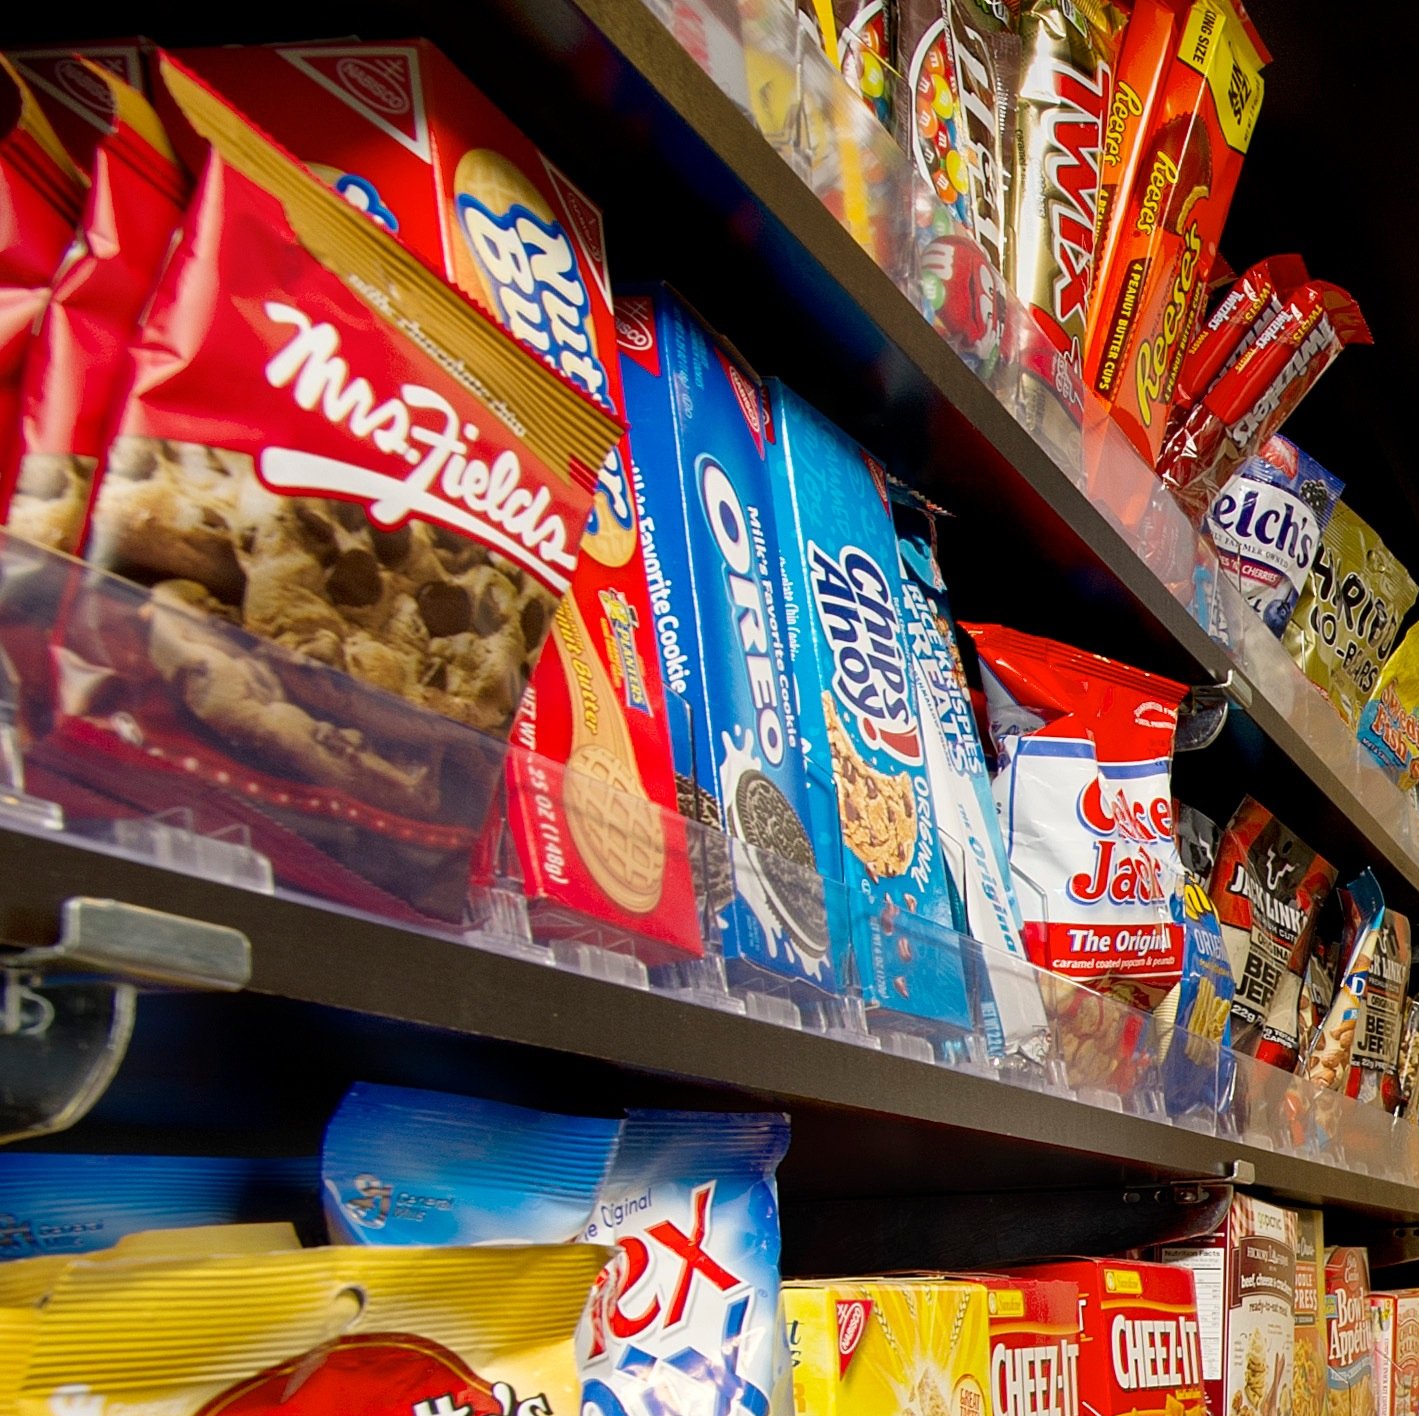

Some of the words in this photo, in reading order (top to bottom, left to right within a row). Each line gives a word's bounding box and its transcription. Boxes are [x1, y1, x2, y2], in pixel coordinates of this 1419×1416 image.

[1103, 81, 1142, 167] Reese's
[1137, 151, 1179, 234] Reese's
[1126, 275, 1142, 318] PEANUT
[1099, 359, 1117, 391] CUPS
[1112, 320, 1131, 358] BUTTER
[402, 384, 577, 572] Fields
[1213, 491, 1314, 570] elch's
[703, 463, 784, 766] OREO
[747, 506, 768, 573] Milk's
[759, 576, 785, 671] Favorite
[779, 675, 797, 748] Cookie
[657, 617, 688, 696] Cookie
[933, 648, 982, 775] KRISPIES
[1052, 958, 1095, 970] caramel
[1095, 957, 1121, 969] coated
[1069, 929, 1110, 953] The
[1195, 1248, 1222, 1258] Facts
[841, 1305, 862, 1352] NABISCO
[1335, 1288, 1366, 1328] Bowl
[1111, 1313, 1201, 1395] CHEEZ-IT
